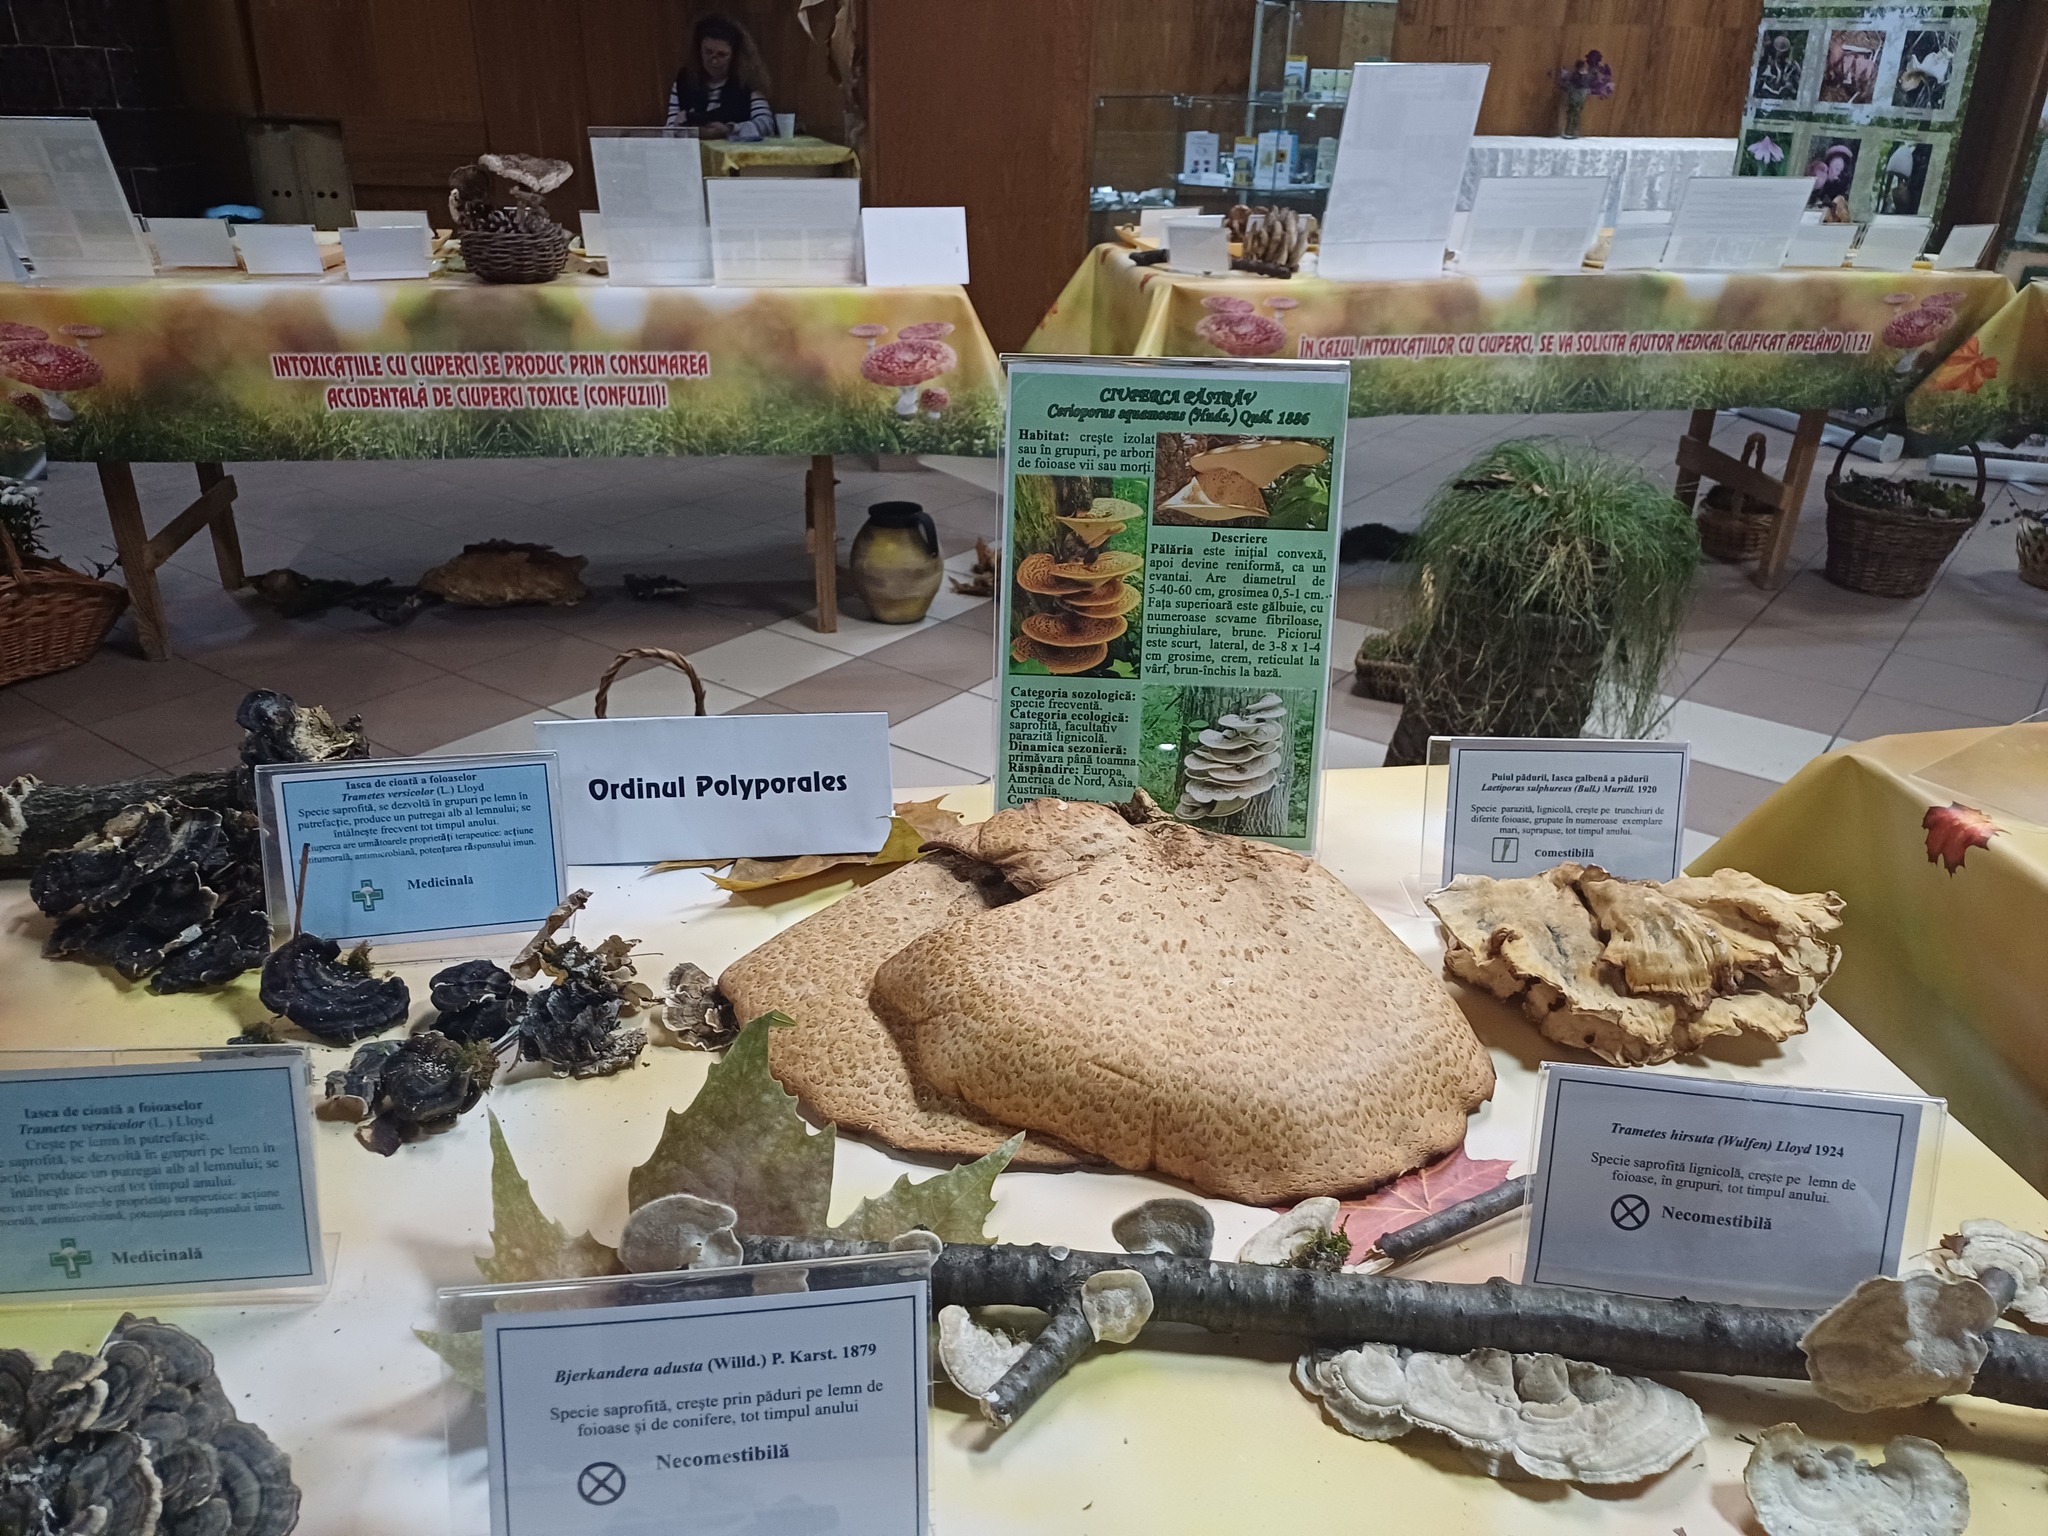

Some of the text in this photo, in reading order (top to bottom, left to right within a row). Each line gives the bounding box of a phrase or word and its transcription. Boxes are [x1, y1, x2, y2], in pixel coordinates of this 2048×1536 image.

[1300, 336, 1314, 358] ÎN
[1318, 338, 1355, 358] CAZUL
[1458, 336, 1473, 354] CU
[1479, 335, 1534, 354] CIUPERCI,
[1540, 335, 1553, 353] SE
[1559, 335, 1573, 353] VA
[1576, 333, 1626, 352] SOLICITA
[1630, 333, 1675, 354] AJUTOR
[1678, 333, 1722, 352] MEDICAL
[1728, 332, 1786, 352] CALIFICAT
[1788, 328, 1841, 351] APELÂND
[1844, 333, 1872, 351] 112!
[387, 355, 406, 376] CU
[411, 355, 478, 377] CIUPERCI
[484, 355, 501, 376] SE
[505, 354, 563, 377] PRODUC
[570, 354, 604, 377] PRIN
[610, 354, 708, 377] CONSUMAREA
[327, 382, 667, 409] ACCIDENTALĂ DE CIUPERCI TOXICE (CONFUZII)!
[1099, 386, 1180, 405] CIUPERCA
[1188, 408, 1237, 427] (Huds.)
[1276, 411, 1311, 425] 1886
[1018, 428, 1155, 445] Habitat: crește izolat
[1017, 443, 1155, 459] sau în grupuri, pe arbori
[1017, 456, 1154, 474] de foioase vii sau morți.
[1210, 531, 1267, 543] Descriere
[1150, 542, 1326, 561] Pălăria este inițial convexă,
[1011, 686, 1135, 702] Categoria sozologică:
[1010, 699, 1102, 710] specie frecventă.
[1010, 711, 1129, 723] Categoria ecologică:
[345, 781, 371, 789] Iasca
[374, 778, 386, 787] de
[388, 776, 418, 786] cioată
[588, 770, 847, 800] Ordinul Polyporales
[1491, 772, 1513, 781] Puiul
[1515, 773, 1549, 783] pădurii,
[1551, 773, 1573, 781] Iasca
[1574, 774, 1608, 783] galbenă
[1617, 774, 1648, 784] pădurii
[341, 792, 385, 801] Trametes
[387, 787, 434, 798] versicolor
[456, 782, 484, 794] Lloyd
[1007, 784, 1060, 795] Australia.
[1481, 783, 1524, 793] Laetiporus
[1526, 783, 1572, 794] sulphureus
[1638, 785, 1657, 793] 1920
[298, 808, 330, 818] Specie
[332, 803, 376, 815] saprofită,
[390, 798, 430, 810] dezvoltă
[432, 797, 442, 806] în
[444, 794, 478, 808] grupuri
[480, 796, 491, 805] pe
[493, 793, 516, 802] lemn
[518, 791, 528, 800] în
[1470, 803, 1664, 815] Specie parazită, lignicolă, crește pe trunchiuri de
[1501, 814, 1532, 824] foioase,
[1533, 817, 1563, 825] grupate
[1565, 815, 1573, 823] în
[1621, 816, 1662, 827] exemplare
[1521, 827, 1563, 836] suprapuse,
[1577, 826, 1603, 837] timpul
[1534, 847, 1594, 857] Comestibilă
[407, 874, 473, 889] Medicinală
[1611, 1122, 1844, 1157] Trametes hirsuta (Wulfen) Lloyd 1924
[1590, 1151, 1856, 1190] Specie saprofită lignicolă, crește pe lemn de
[1611, 1169, 1656, 1185] foioase,
[1660, 1174, 1672, 1185] în
[1675, 1178, 1722, 1192] grupuri,
[1727, 1183, 1743, 1194] tot
[1746, 1184, 1785, 1199] timpul
[1661, 1205, 1771, 1230] Necomestibilă
[111, 1247, 202, 1264] Medicinală
[554, 1343, 876, 1385] Bjerkandera adusta (Willd.) P. Karst. 1879
[550, 1379, 883, 1423] Specie saprofită, crește prin păduri pe lemn de
[577, 1399, 858, 1436] foioase și de conifere, tot timpul anului
[655, 1443, 789, 1469] Necomestibilă
